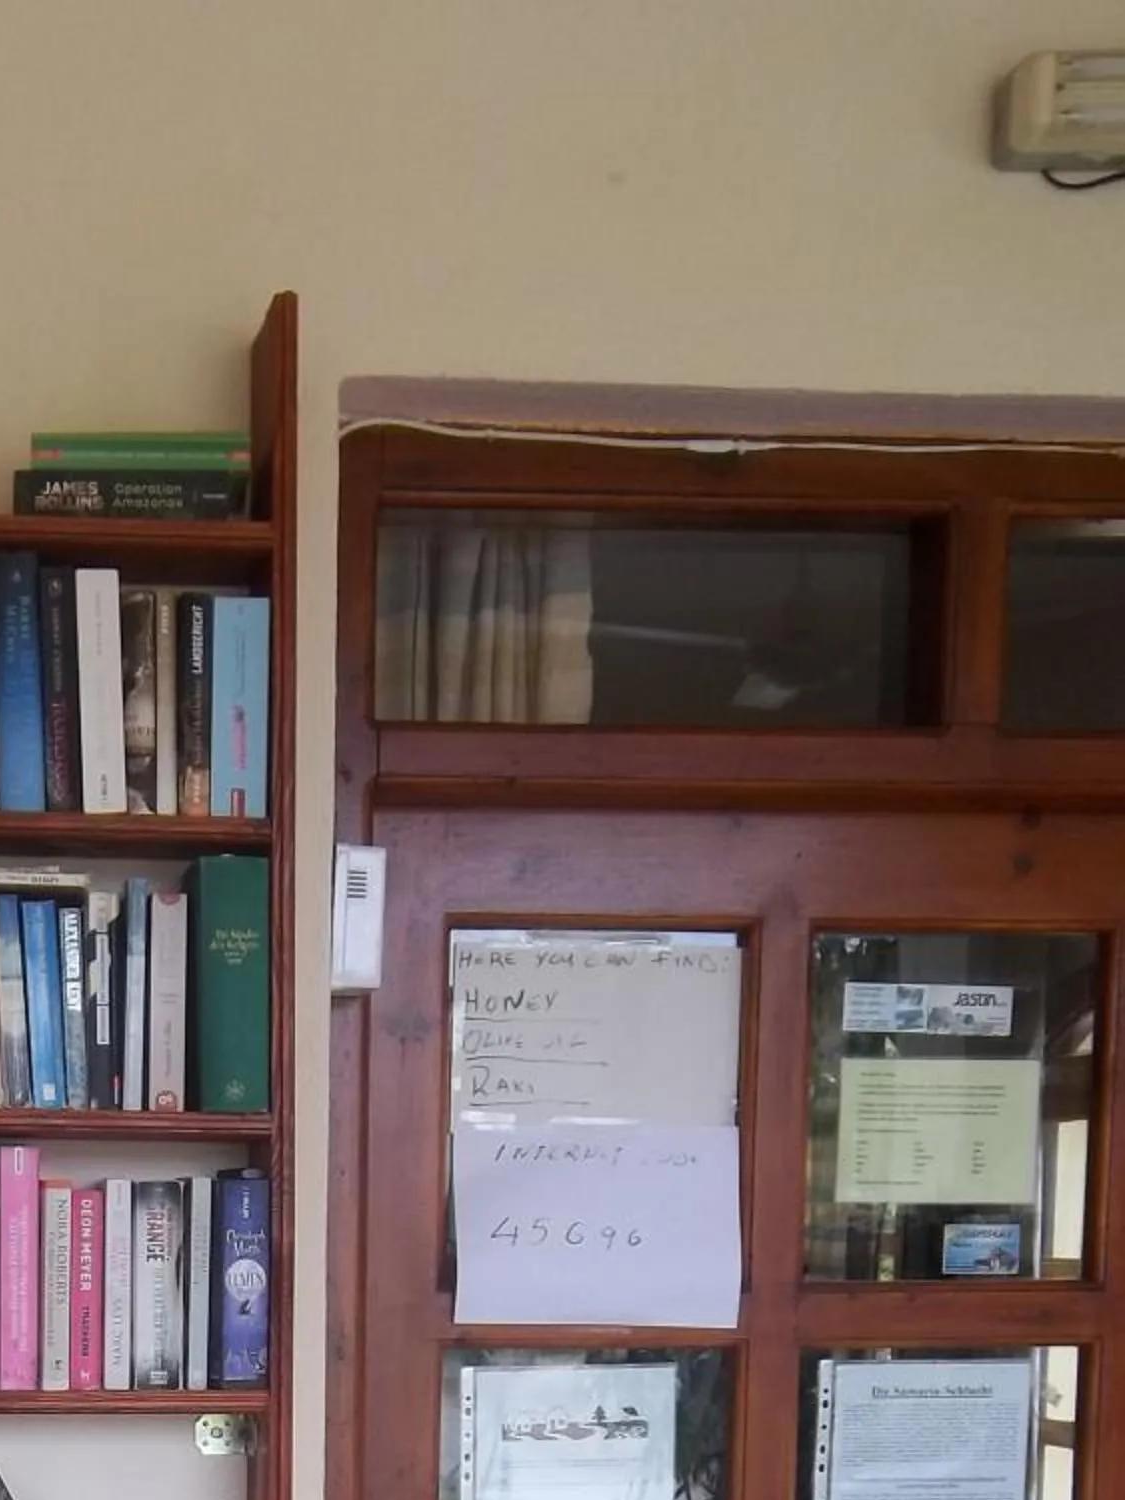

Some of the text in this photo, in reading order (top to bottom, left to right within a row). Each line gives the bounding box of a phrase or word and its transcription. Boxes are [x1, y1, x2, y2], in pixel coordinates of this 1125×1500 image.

[43, 480, 99, 496] JAMES
[465, 989, 559, 1014] HONEY
[80, 1199, 94, 1239] DEON
[80, 1241, 94, 1292] MEYER
